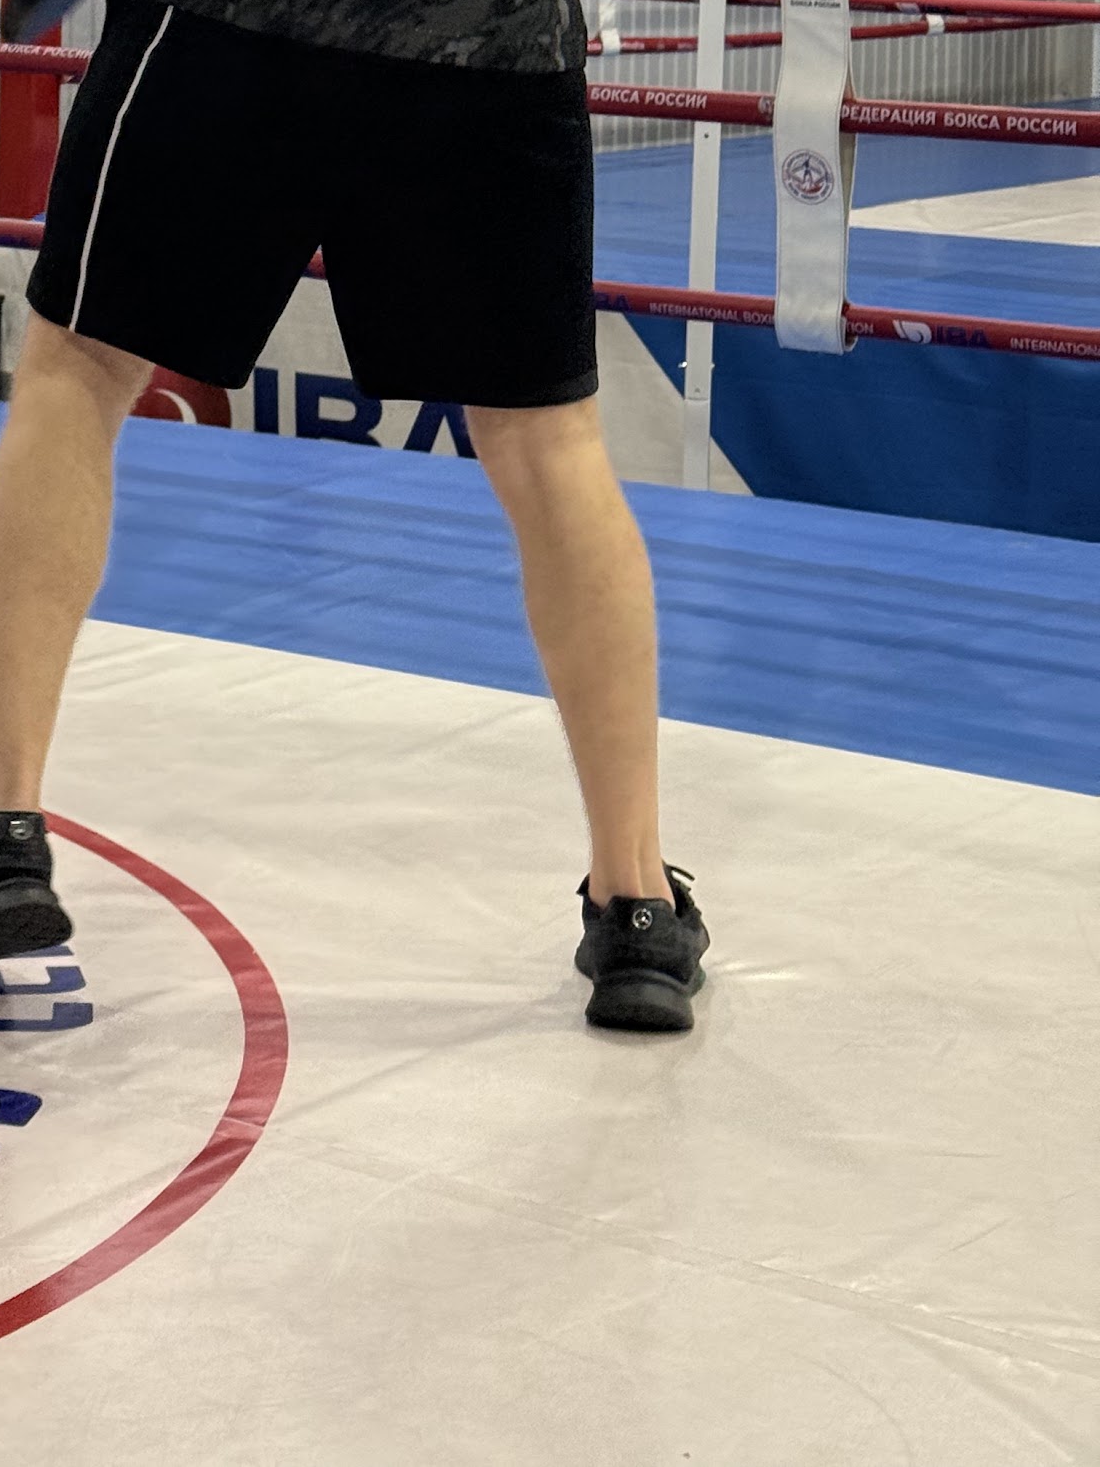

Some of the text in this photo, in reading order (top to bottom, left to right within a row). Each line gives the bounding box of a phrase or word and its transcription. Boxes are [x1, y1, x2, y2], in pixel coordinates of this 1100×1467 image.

[590, 87, 708, 109] БОКСА РОССИИ
[943, 110, 1001, 130] БОКСА
[1006, 115, 1078, 136] РОССИИ
[649, 301, 740, 322] INTERNATIONAL
